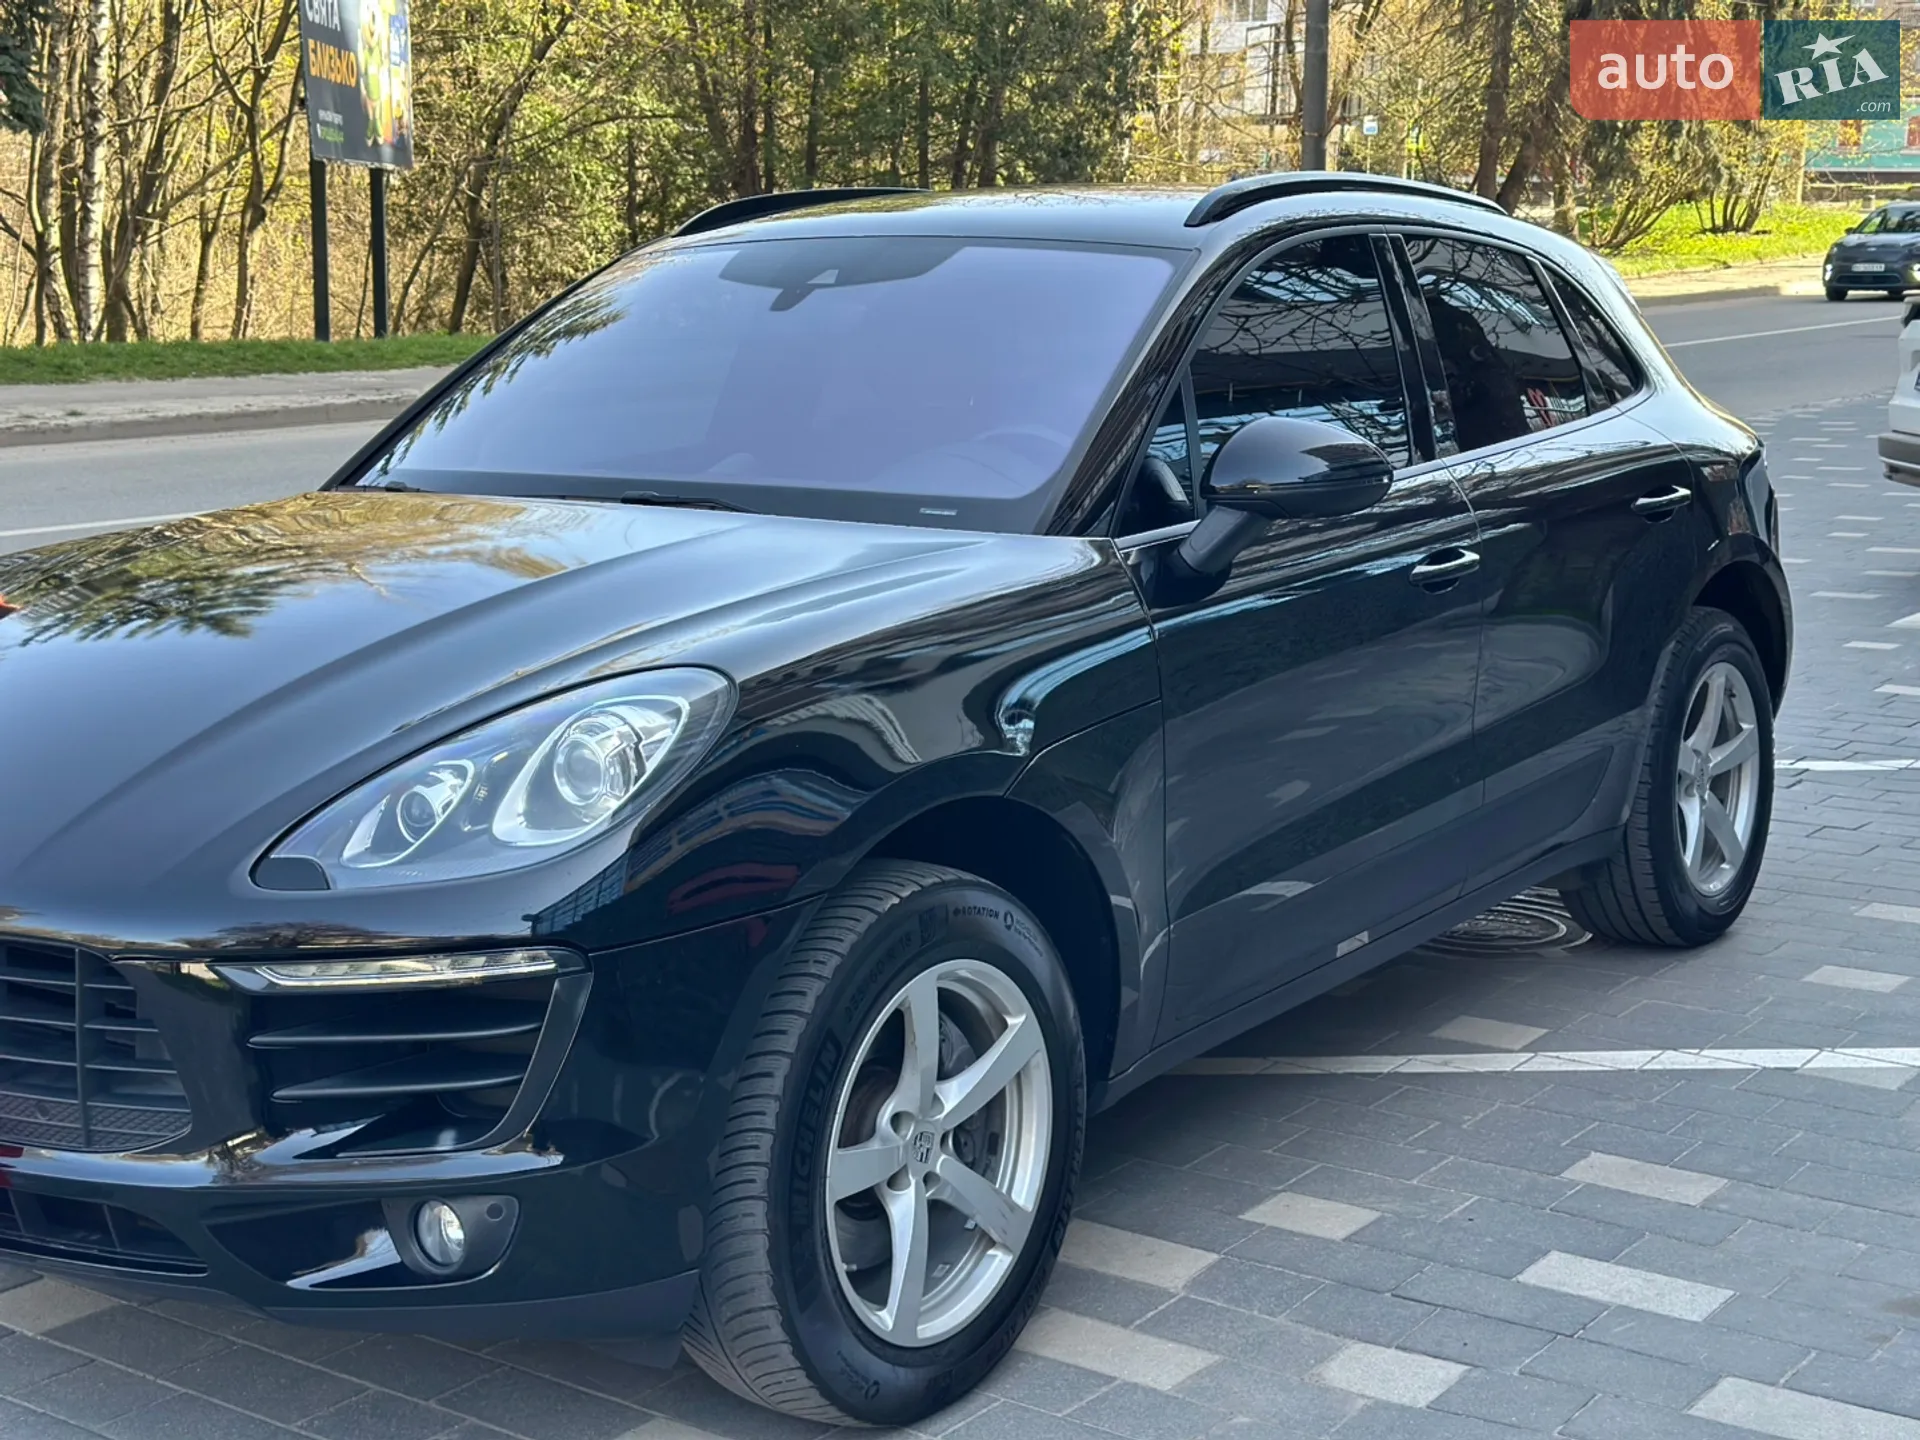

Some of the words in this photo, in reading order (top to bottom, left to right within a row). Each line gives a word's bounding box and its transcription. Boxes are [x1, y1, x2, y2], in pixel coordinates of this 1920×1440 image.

[308, 38, 357, 88] БЛИЗЬКО
[961, 905, 1000, 920] ROTATION
[790, 1034, 838, 1232] MICHELIN
